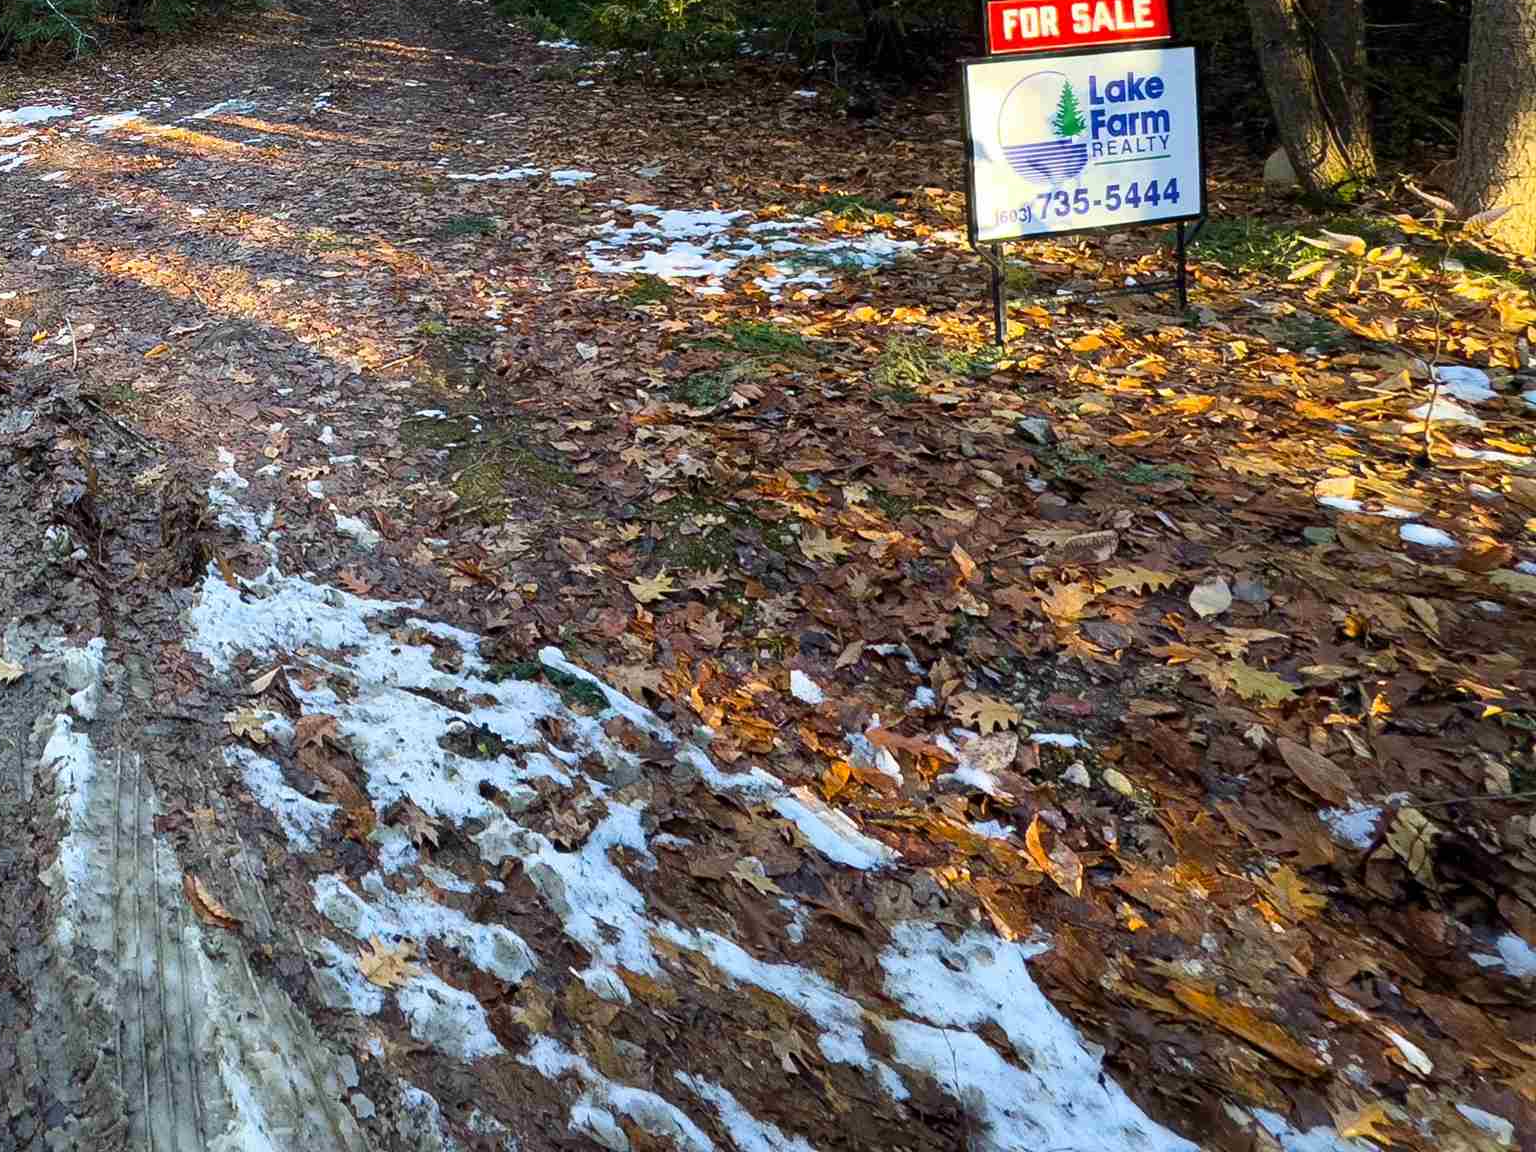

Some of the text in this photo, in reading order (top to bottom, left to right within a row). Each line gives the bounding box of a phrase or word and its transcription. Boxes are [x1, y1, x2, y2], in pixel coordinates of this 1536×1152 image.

[1002, 7, 1060, 40] FOR
[1088, 72, 1164, 105] Lake
[1090, 108, 1170, 140] Farm
[1092, 135, 1171, 157] REALTY
[1036, 177, 1180, 219] 735-5444
